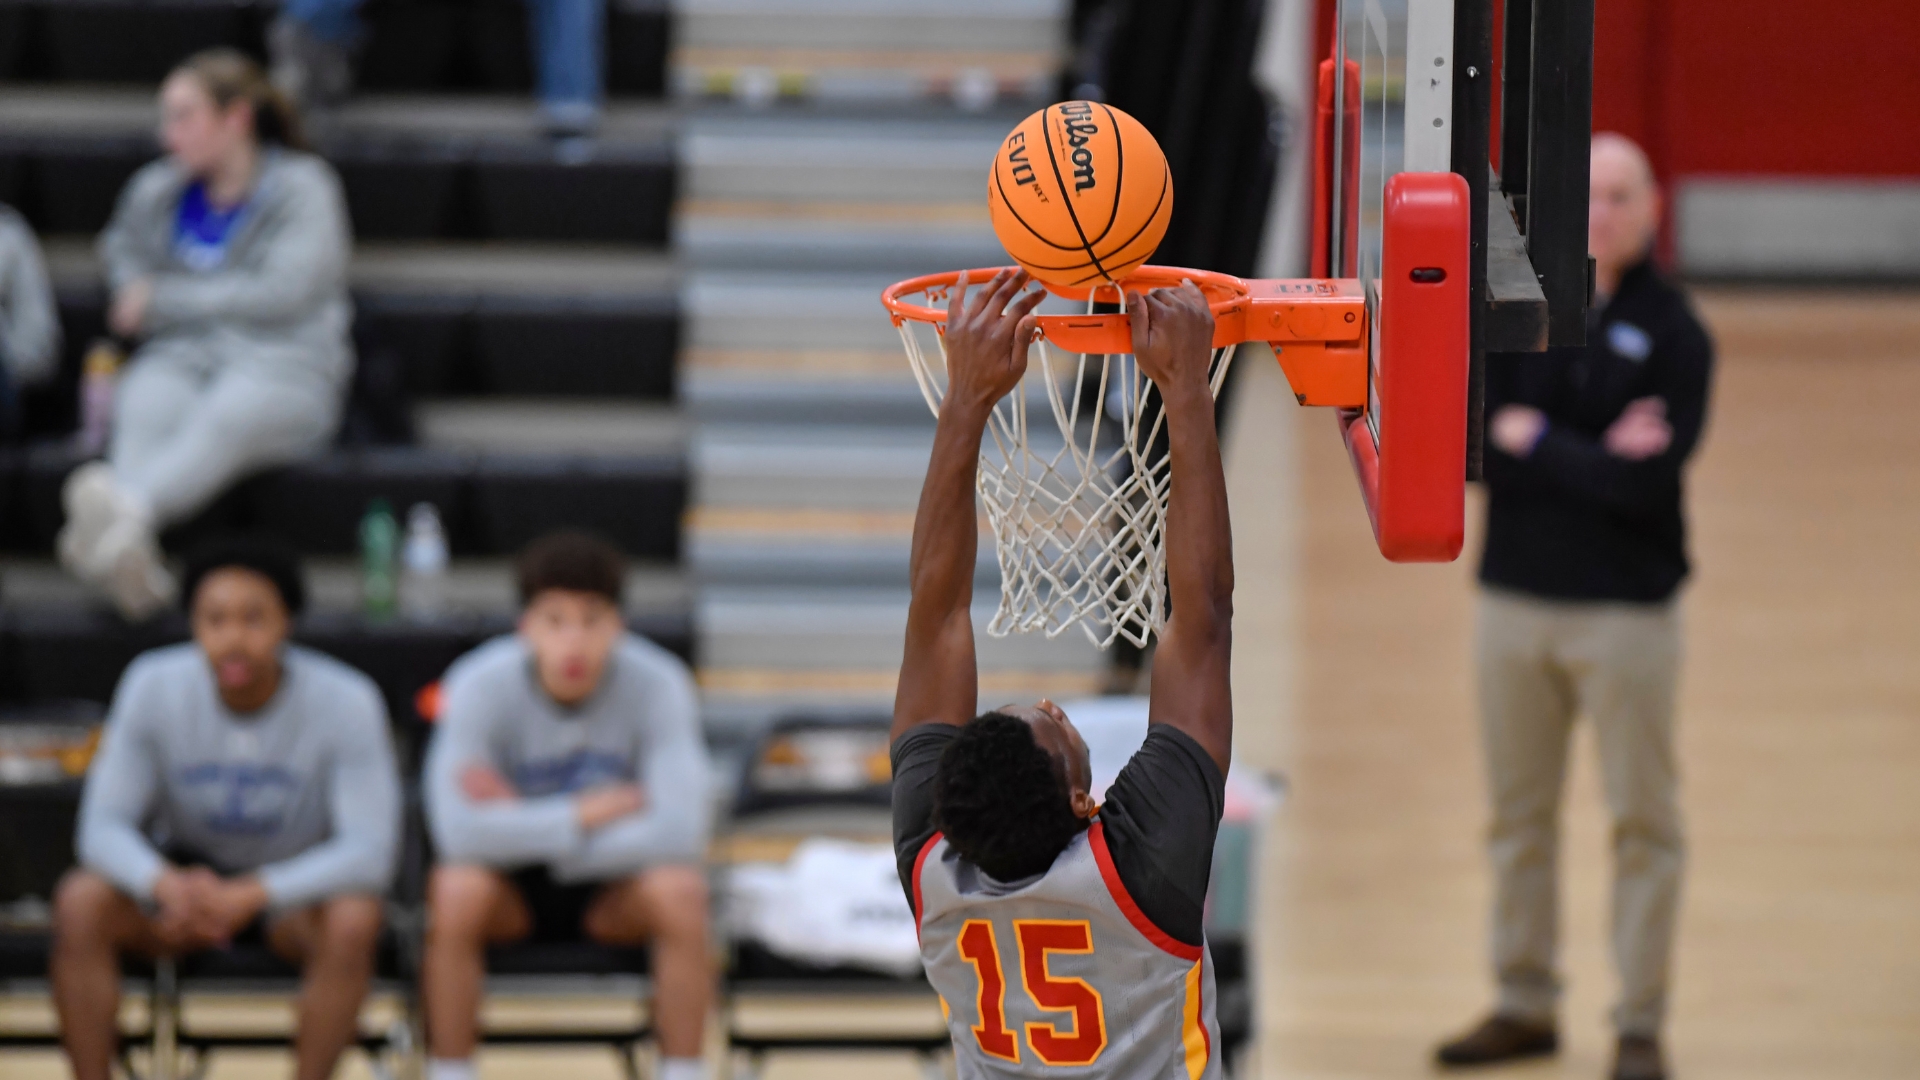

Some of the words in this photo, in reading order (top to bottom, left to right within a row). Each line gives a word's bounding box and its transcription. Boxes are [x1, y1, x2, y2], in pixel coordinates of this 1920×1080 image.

[1008, 131, 1037, 186] EVO
[1031, 183, 1050, 204] NXT
[1059, 101, 1099, 192] Wilson
[956, 918, 1108, 1067] 15
